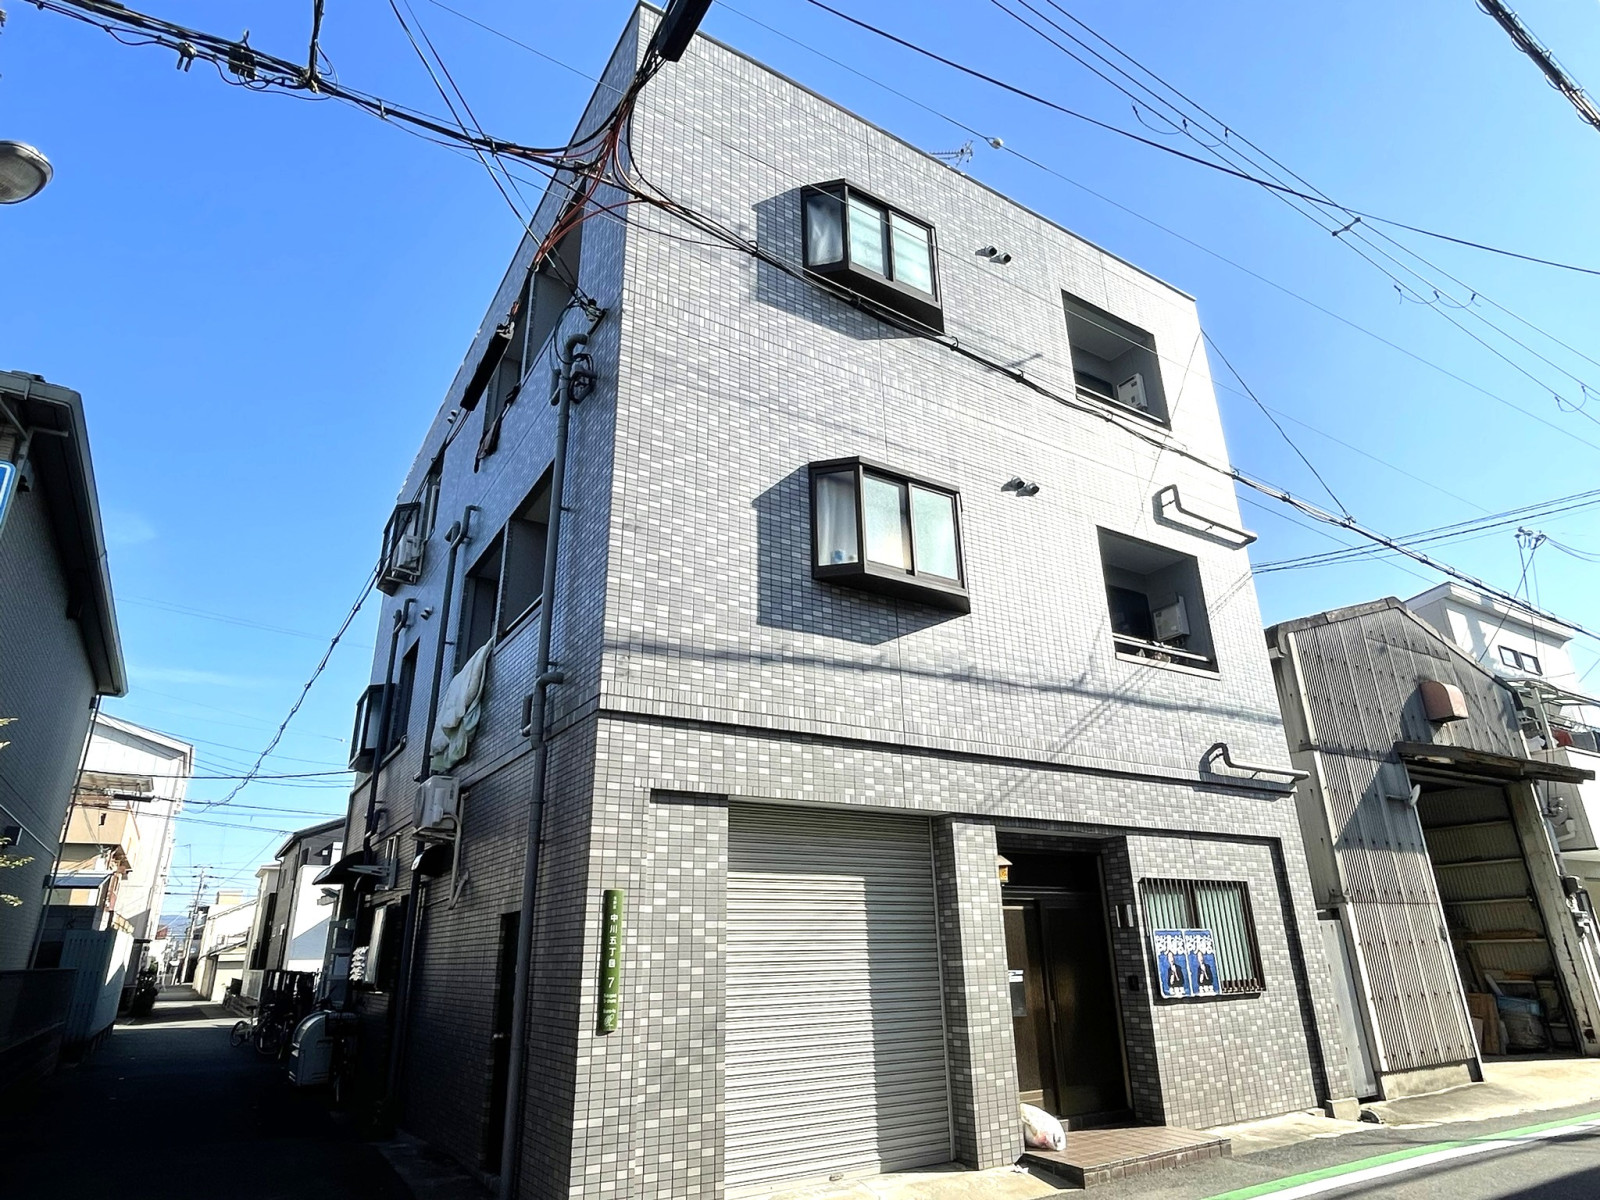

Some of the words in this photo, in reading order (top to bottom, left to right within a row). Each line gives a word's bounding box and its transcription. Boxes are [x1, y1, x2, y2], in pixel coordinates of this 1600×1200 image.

[608, 914, 618, 968] 中川五丁目
[608, 977, 615, 988] 7
